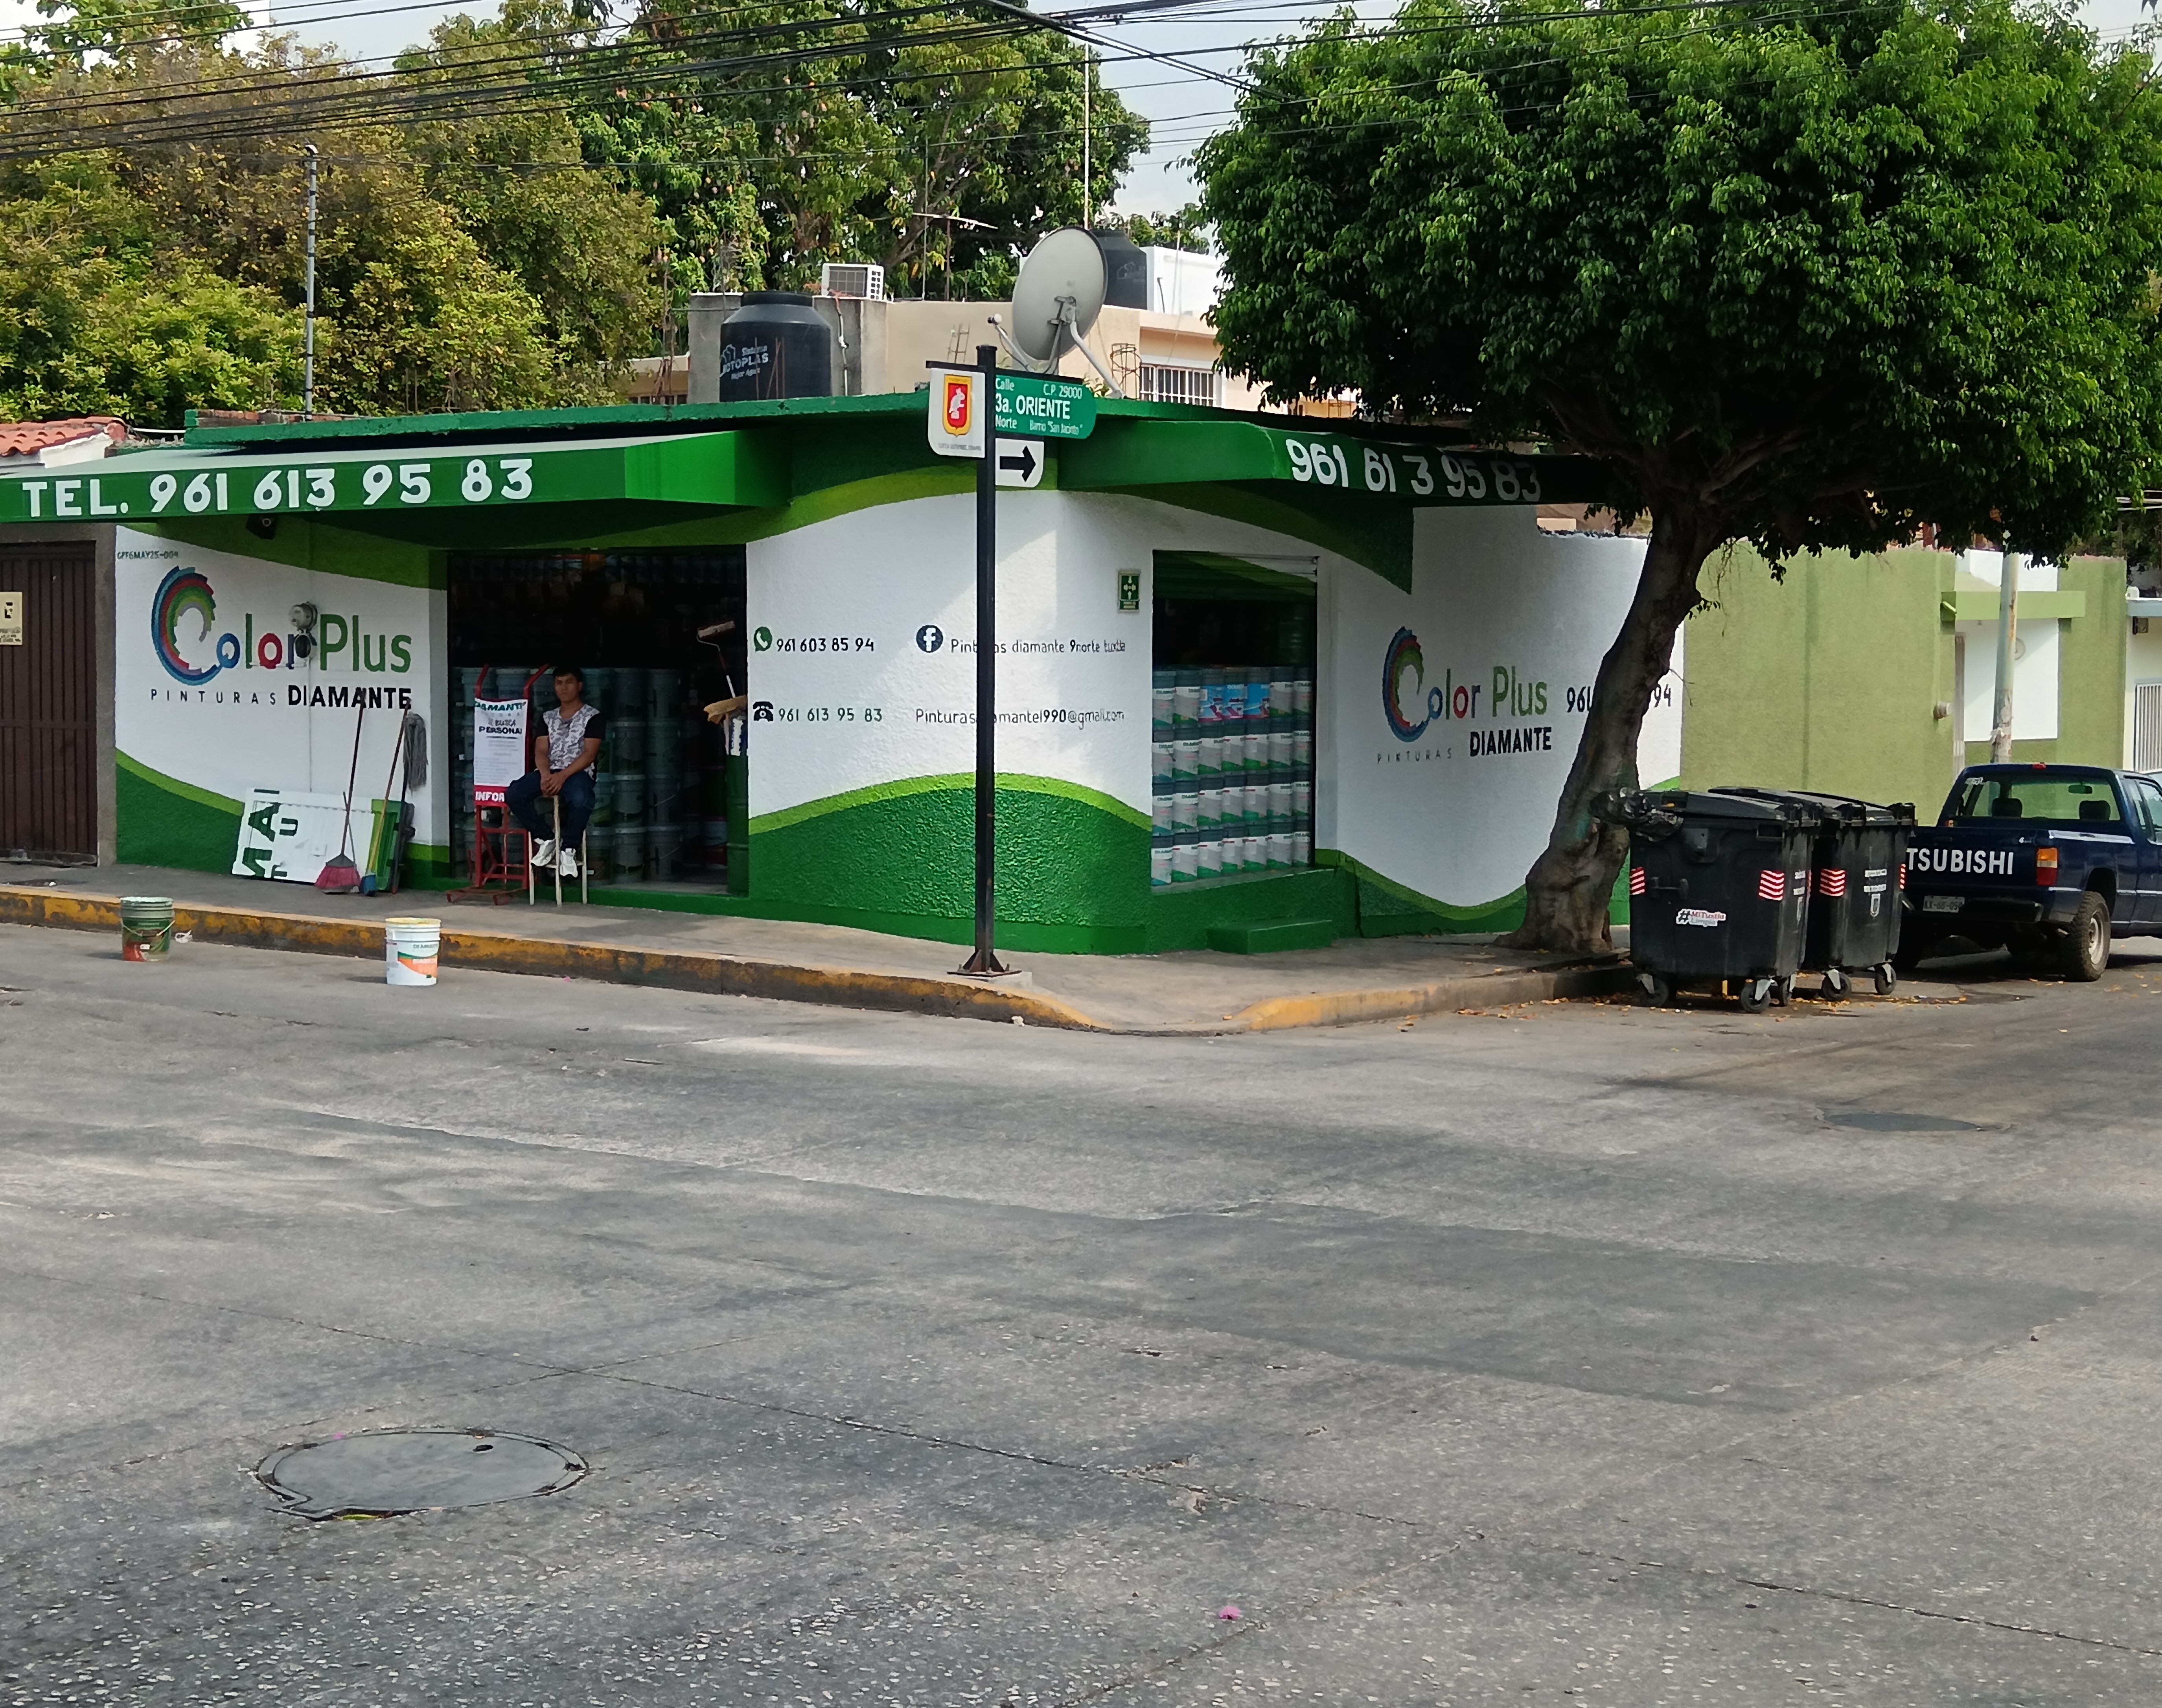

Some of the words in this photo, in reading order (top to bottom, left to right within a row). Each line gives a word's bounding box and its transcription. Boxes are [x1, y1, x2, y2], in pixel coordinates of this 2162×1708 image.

[995, 377, 1015, 391] Calle
[1043, 383, 1057, 396] C.P.
[1059, 385, 1082, 399] 29000
[995, 392, 1012, 413] 3a.
[1016, 395, 1070, 420] ORIENTE
[995, 414, 1018, 429] Norte
[1285, 438, 1349, 488] 961
[1441, 454, 1487, 499] 95
[1490, 461, 1540, 501] 83
[22, 479, 129, 517] TEL.
[150, 473, 228, 512] 961
[254, 468, 335, 510] 613
[362, 464, 431, 505] 95
[461, 458, 533, 502] 83
[320, 613, 412, 673] Plus
[776, 638, 796, 652] 961
[800, 638, 826, 652] 603
[832, 637, 849, 652] 85
[855, 637, 874, 652] 94
[951, 639, 1006, 653] Pintas
[1012, 639, 1065, 653] diamante
[151, 688, 276, 705] PINTURAS
[288, 685, 412, 710] DIAMANTE
[1492, 666, 1547, 717] Plus
[1565, 685, 1591, 713] 961
[1654, 684, 1671, 708] 94
[778, 708, 799, 722] 961
[807, 708, 829, 721] 613
[837, 708, 855, 721] 95
[865, 708, 883, 722] 83
[1377, 747, 1452, 764] PINTURAS
[1470, 727, 1552, 757] DIAMANTE
[1906, 848, 2014, 875] TSUBISHI
